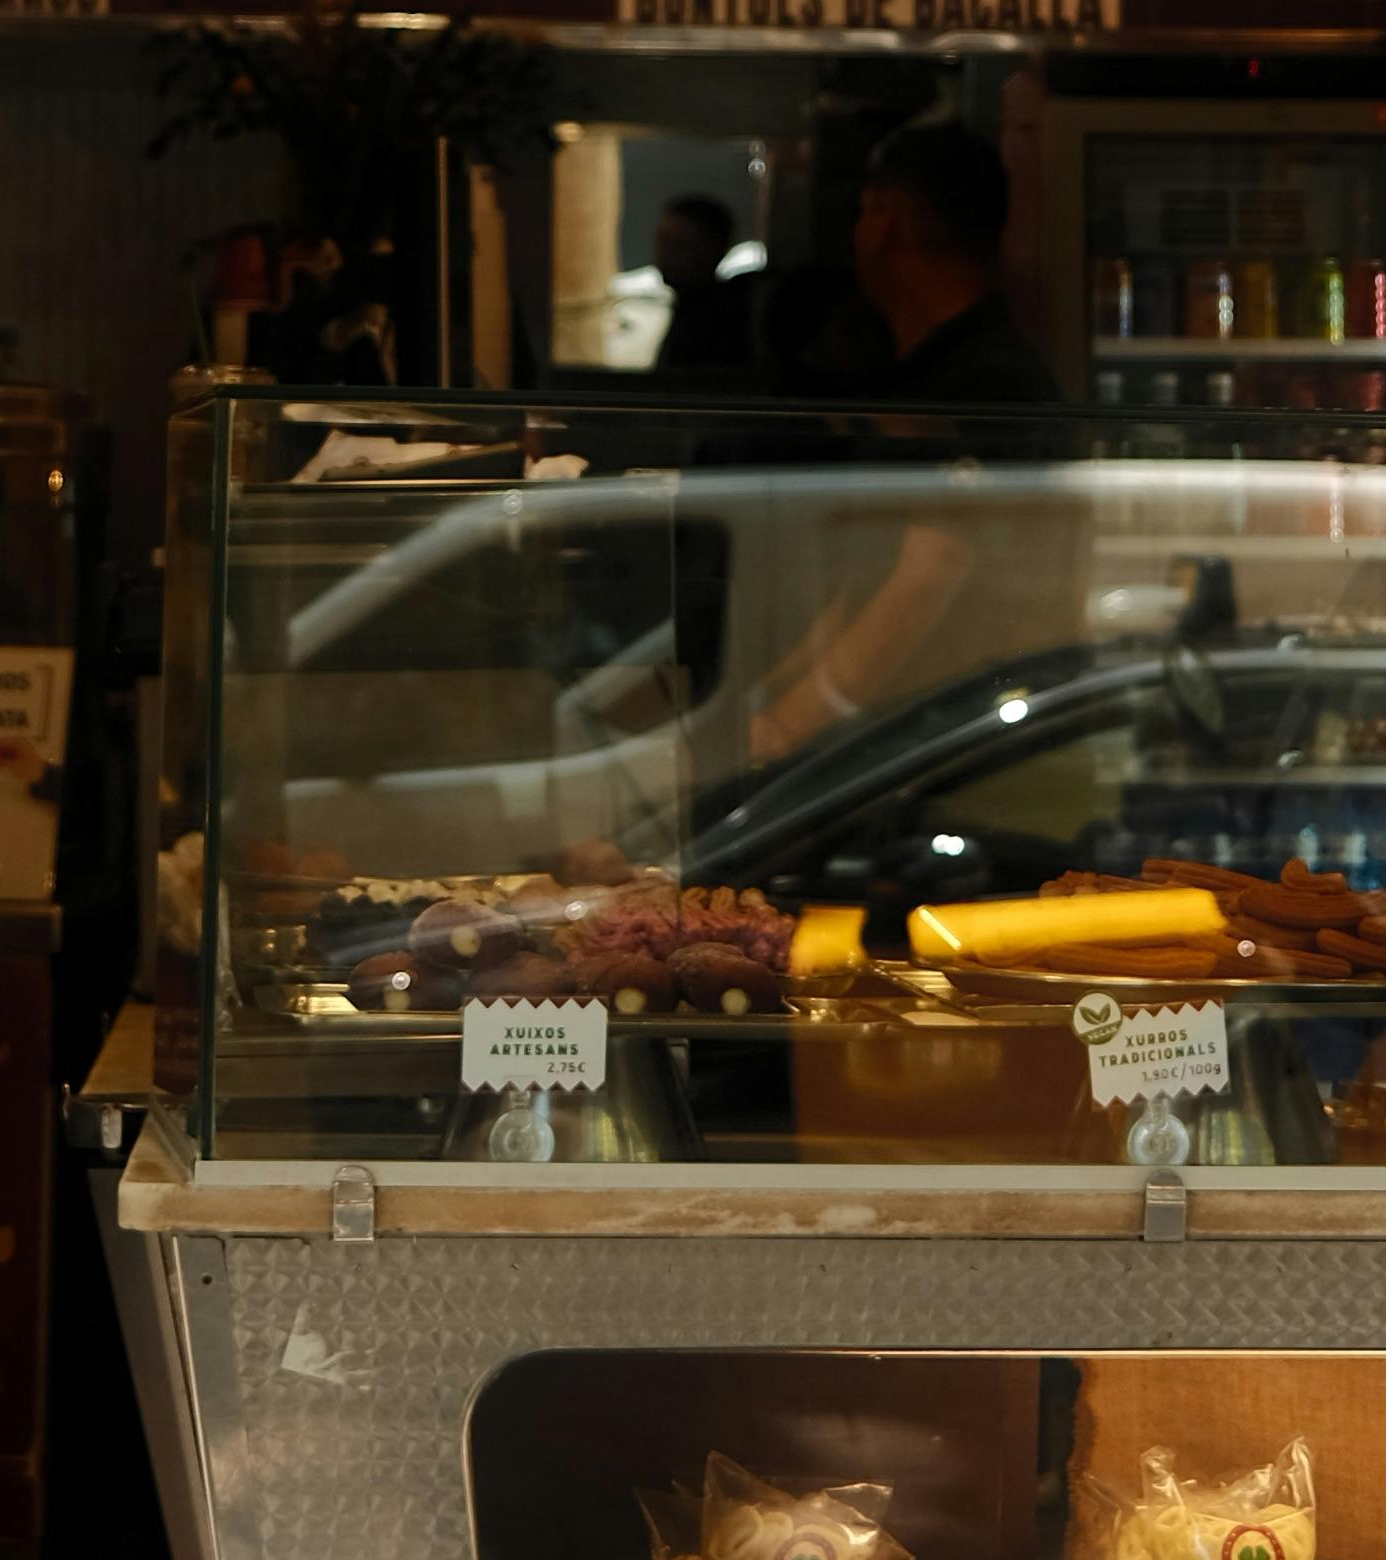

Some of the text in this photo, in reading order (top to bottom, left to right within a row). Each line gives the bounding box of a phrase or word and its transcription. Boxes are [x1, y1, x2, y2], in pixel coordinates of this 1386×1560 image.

[504, 1026, 566, 1039] XUIXOS
[1125, 1028, 1189, 1048] XURROS
[489, 1043, 579, 1056] ARTESANS
[1098, 1041, 1217, 1068] TRADICIONALS
